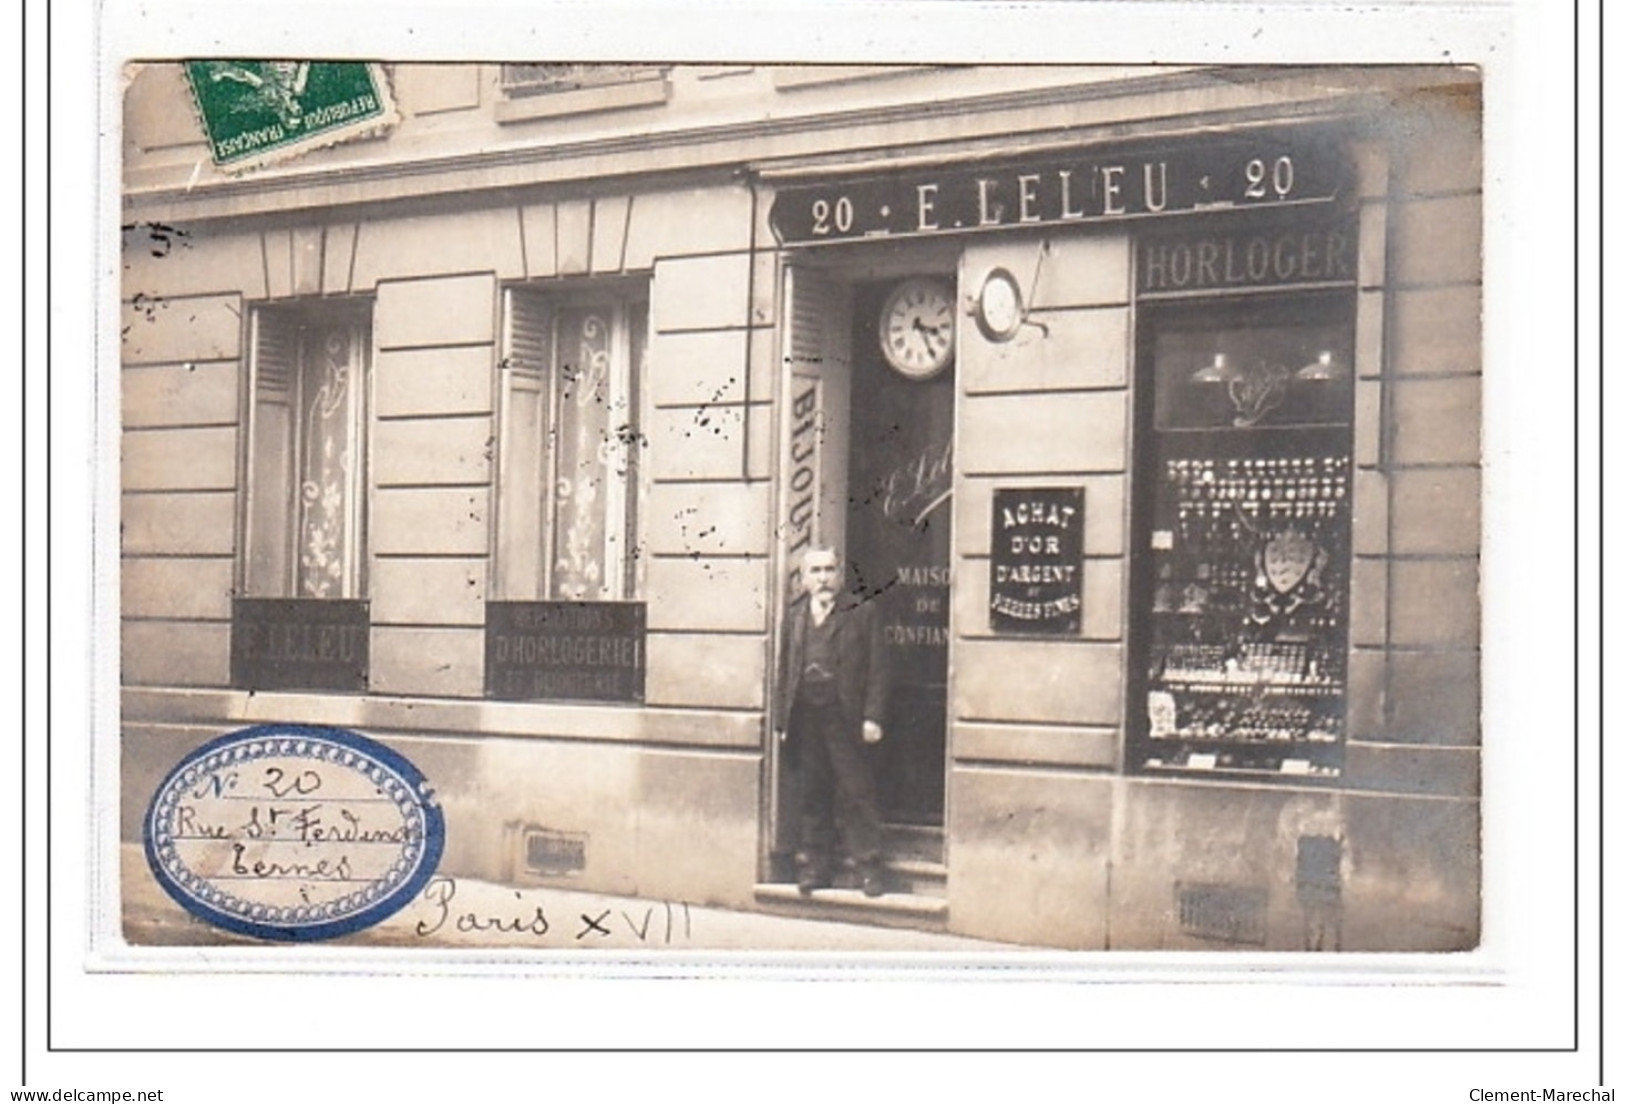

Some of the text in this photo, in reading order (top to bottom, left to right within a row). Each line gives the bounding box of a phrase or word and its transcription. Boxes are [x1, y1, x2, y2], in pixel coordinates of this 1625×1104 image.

[812, 197, 854, 235] 20
[977, 162, 1167, 226] LELEU
[1244, 155, 1295, 200] 20
[1146, 232, 1350, 287] HORLOGER
[1002, 502, 1076, 529] ACHAT
[1011, 536, 1060, 554] D'OR
[997, 565, 1076, 583] D'ARGENT
[262, 767, 322, 798] 20
[176, 805, 233, 840] Rue
[415, 877, 550, 936] Paris
